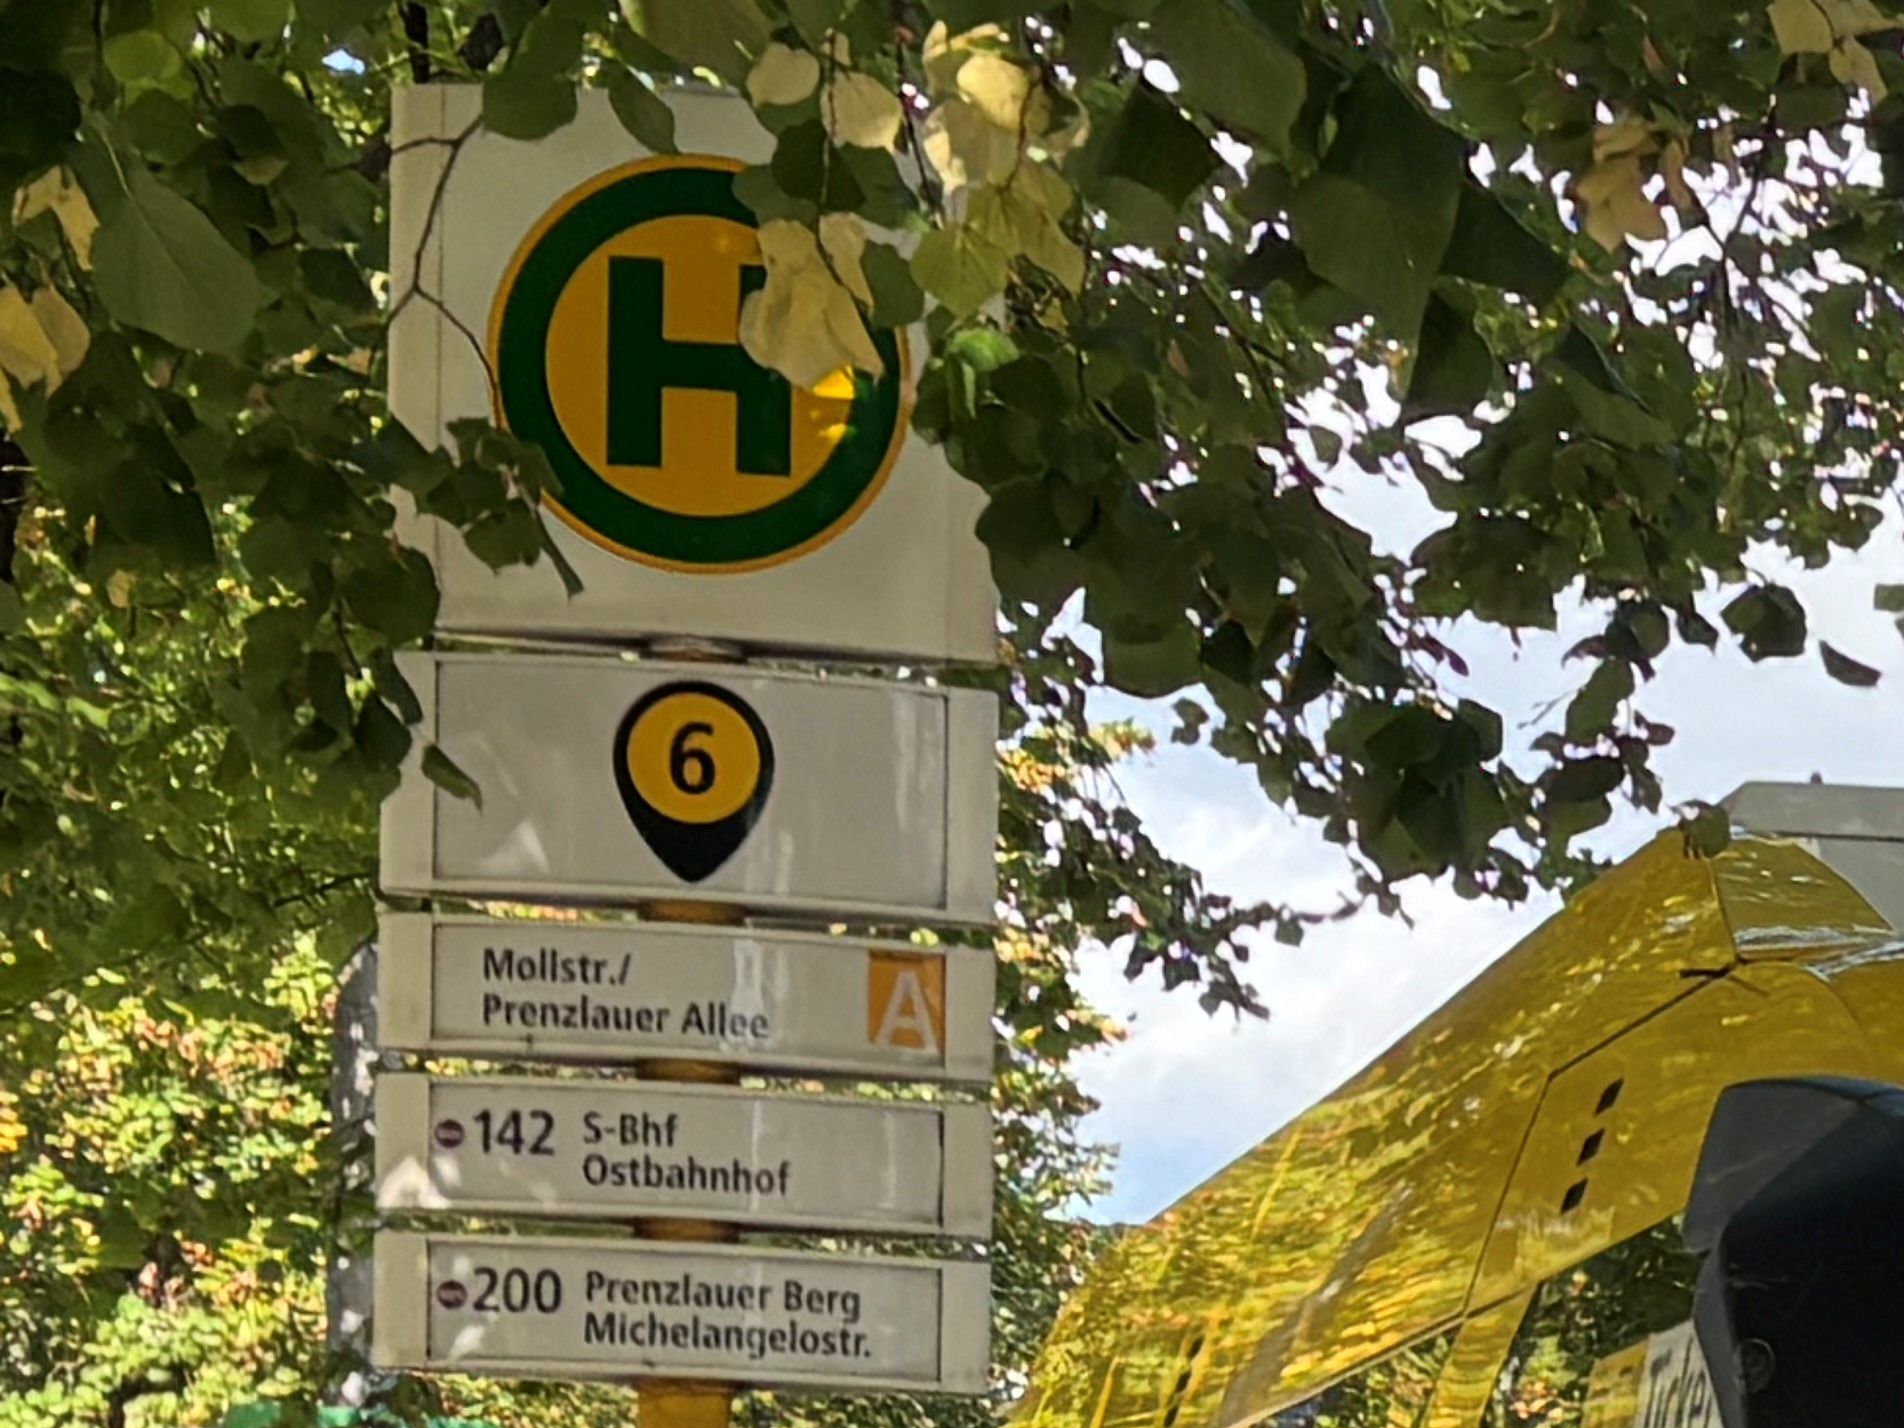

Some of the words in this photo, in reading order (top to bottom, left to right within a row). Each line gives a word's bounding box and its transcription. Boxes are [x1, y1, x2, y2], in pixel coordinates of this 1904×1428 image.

[606, 255, 792, 477] H
[669, 721, 717, 795] 6
[482, 946, 631, 988] Mollstr./
[482, 991, 669, 1036] Prenzlauer
[682, 1001, 770, 1041] Allee
[875, 968, 940, 1057] A
[471, 1108, 555, 1157] 142
[583, 1114, 678, 1150] S-Bhf
[582, 1154, 791, 1197] Ostbahnhof
[471, 1266, 562, 1316] 200
[585, 1270, 773, 1312] Prenzlauer
[783, 1280, 862, 1325] Berg
[583, 1310, 872, 1361] Michelangelostr.
